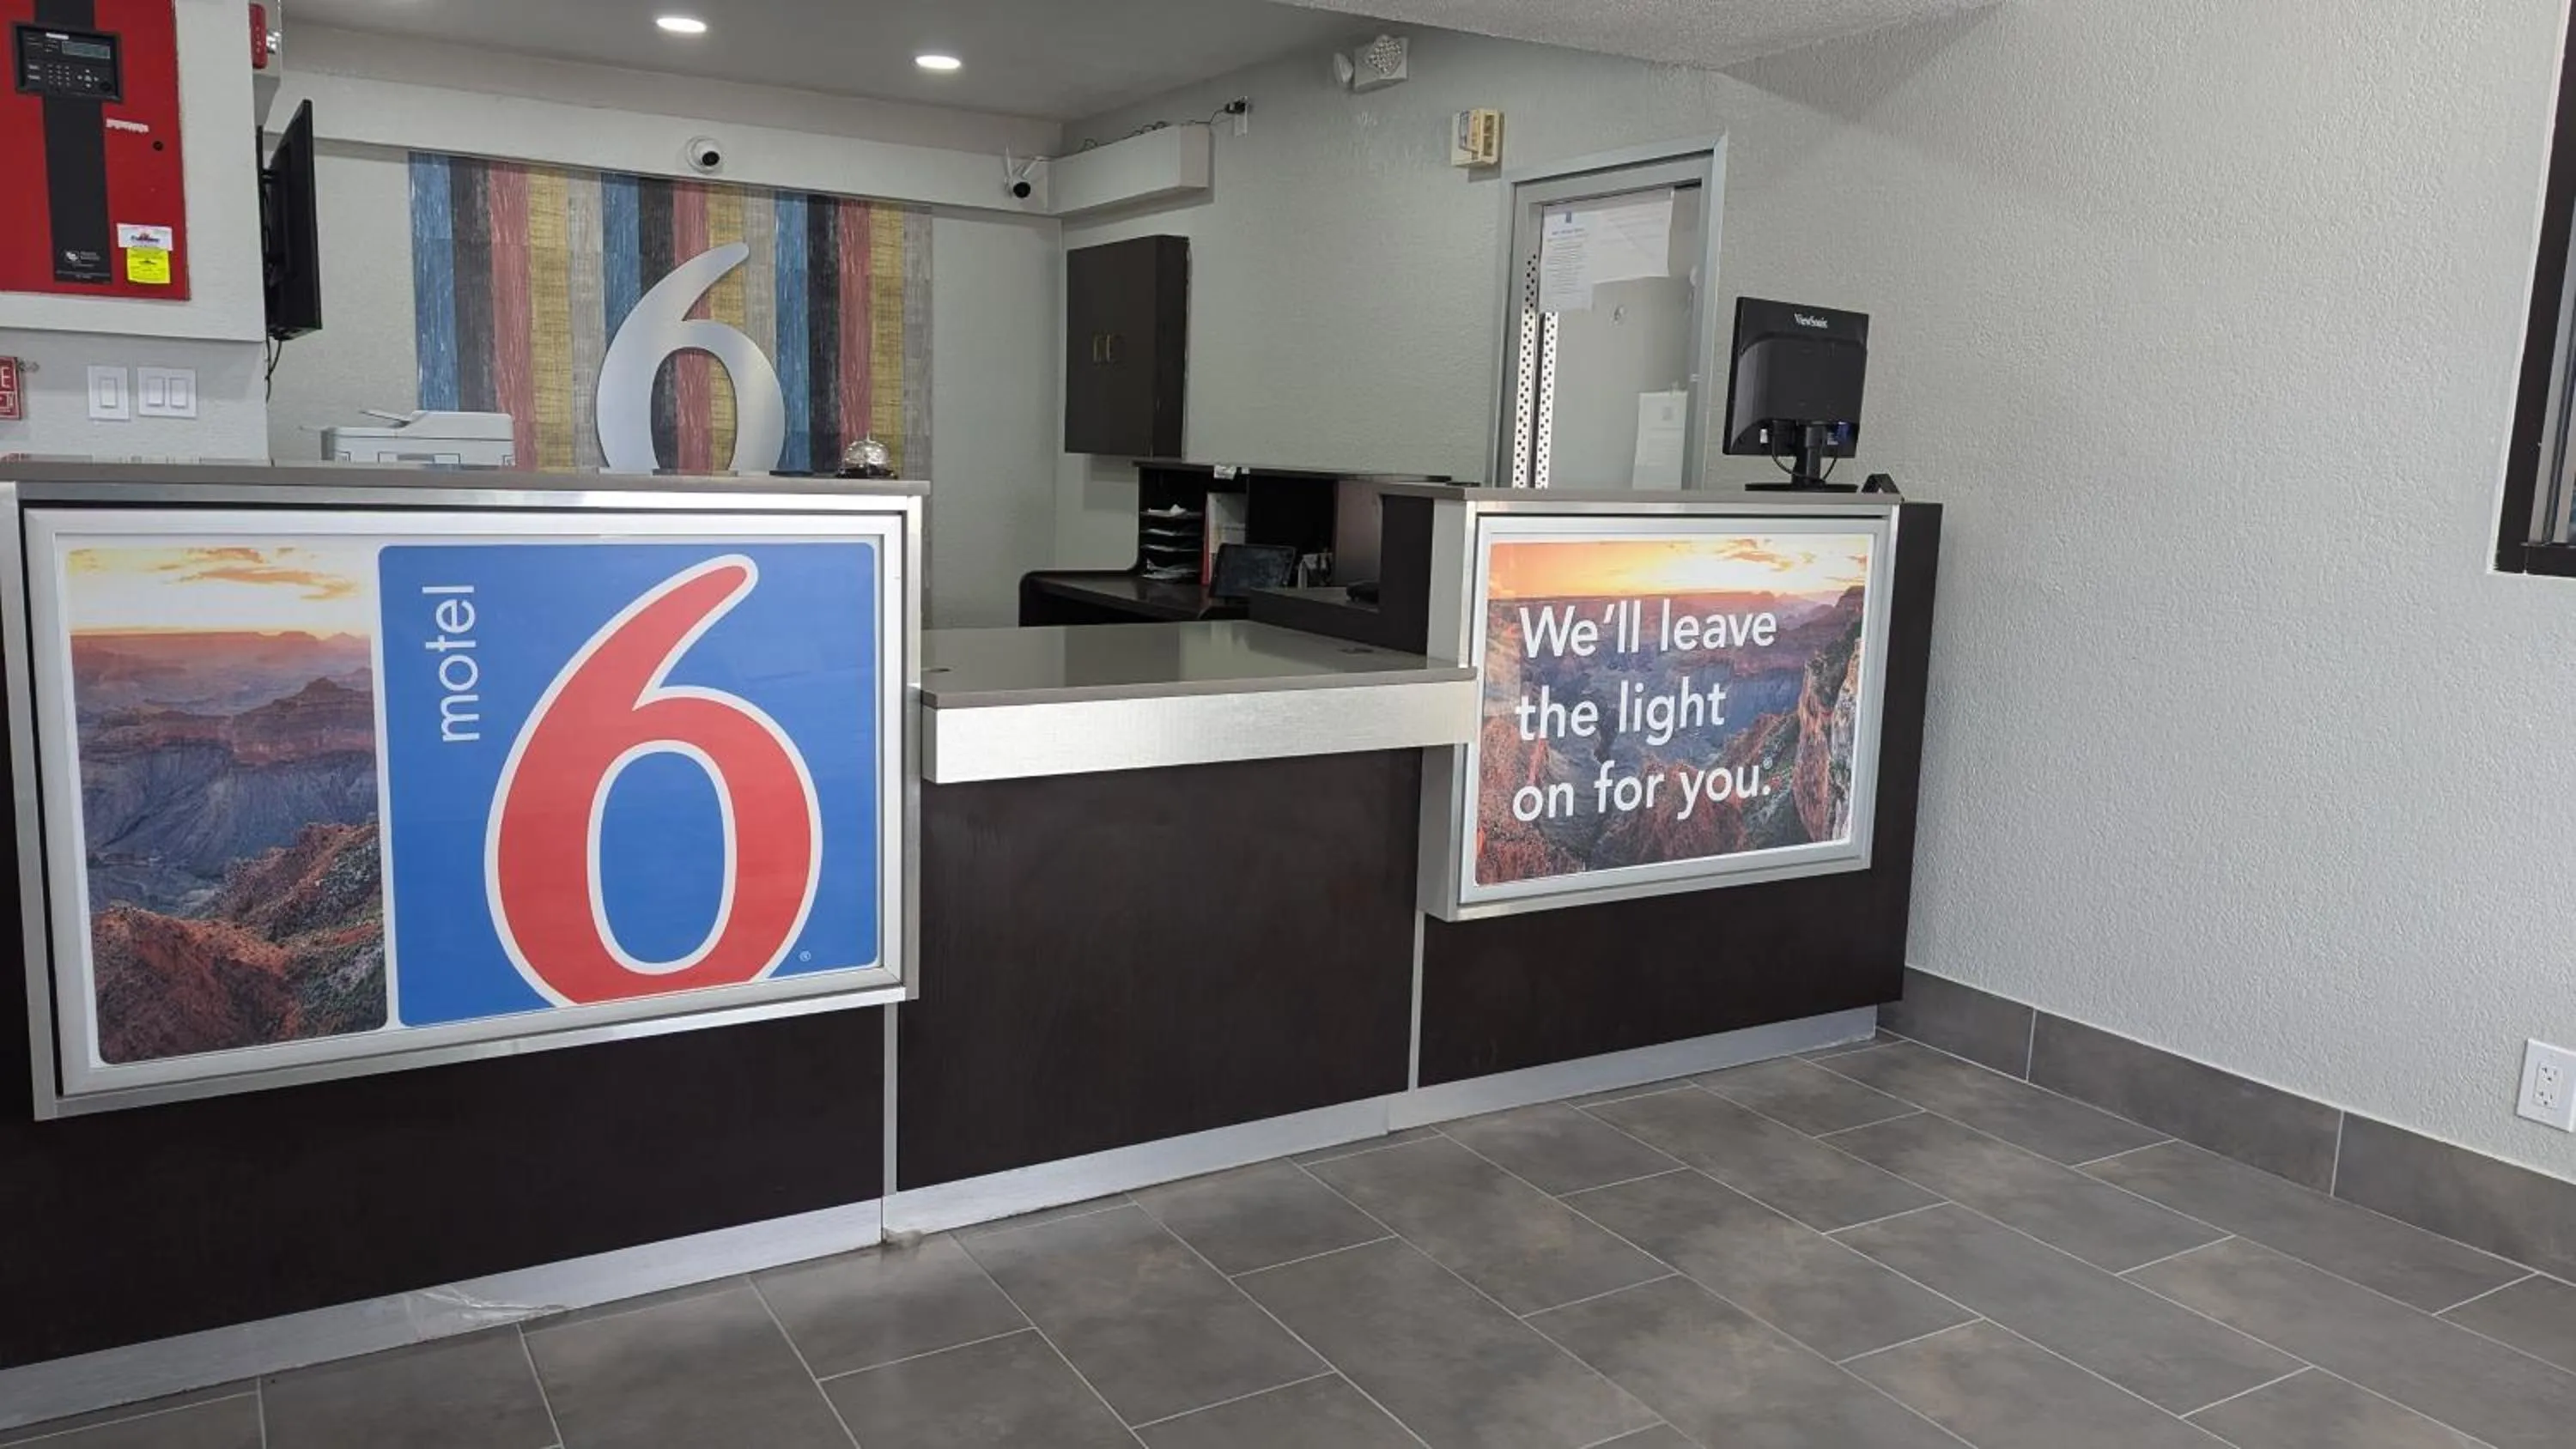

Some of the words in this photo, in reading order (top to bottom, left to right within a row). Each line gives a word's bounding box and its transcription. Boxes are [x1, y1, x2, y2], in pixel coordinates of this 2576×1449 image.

[596, 241, 786, 474] 6
[422, 585, 480, 743] motel
[1520, 598, 1641, 658] We'll
[1661, 598, 1777, 652] leave
[1515, 685, 1599, 742] the
[1619, 676, 1727, 746] light
[484, 553, 823, 1008] 6
[1512, 779, 1574, 822] on
[1594, 760, 1665, 814] for
